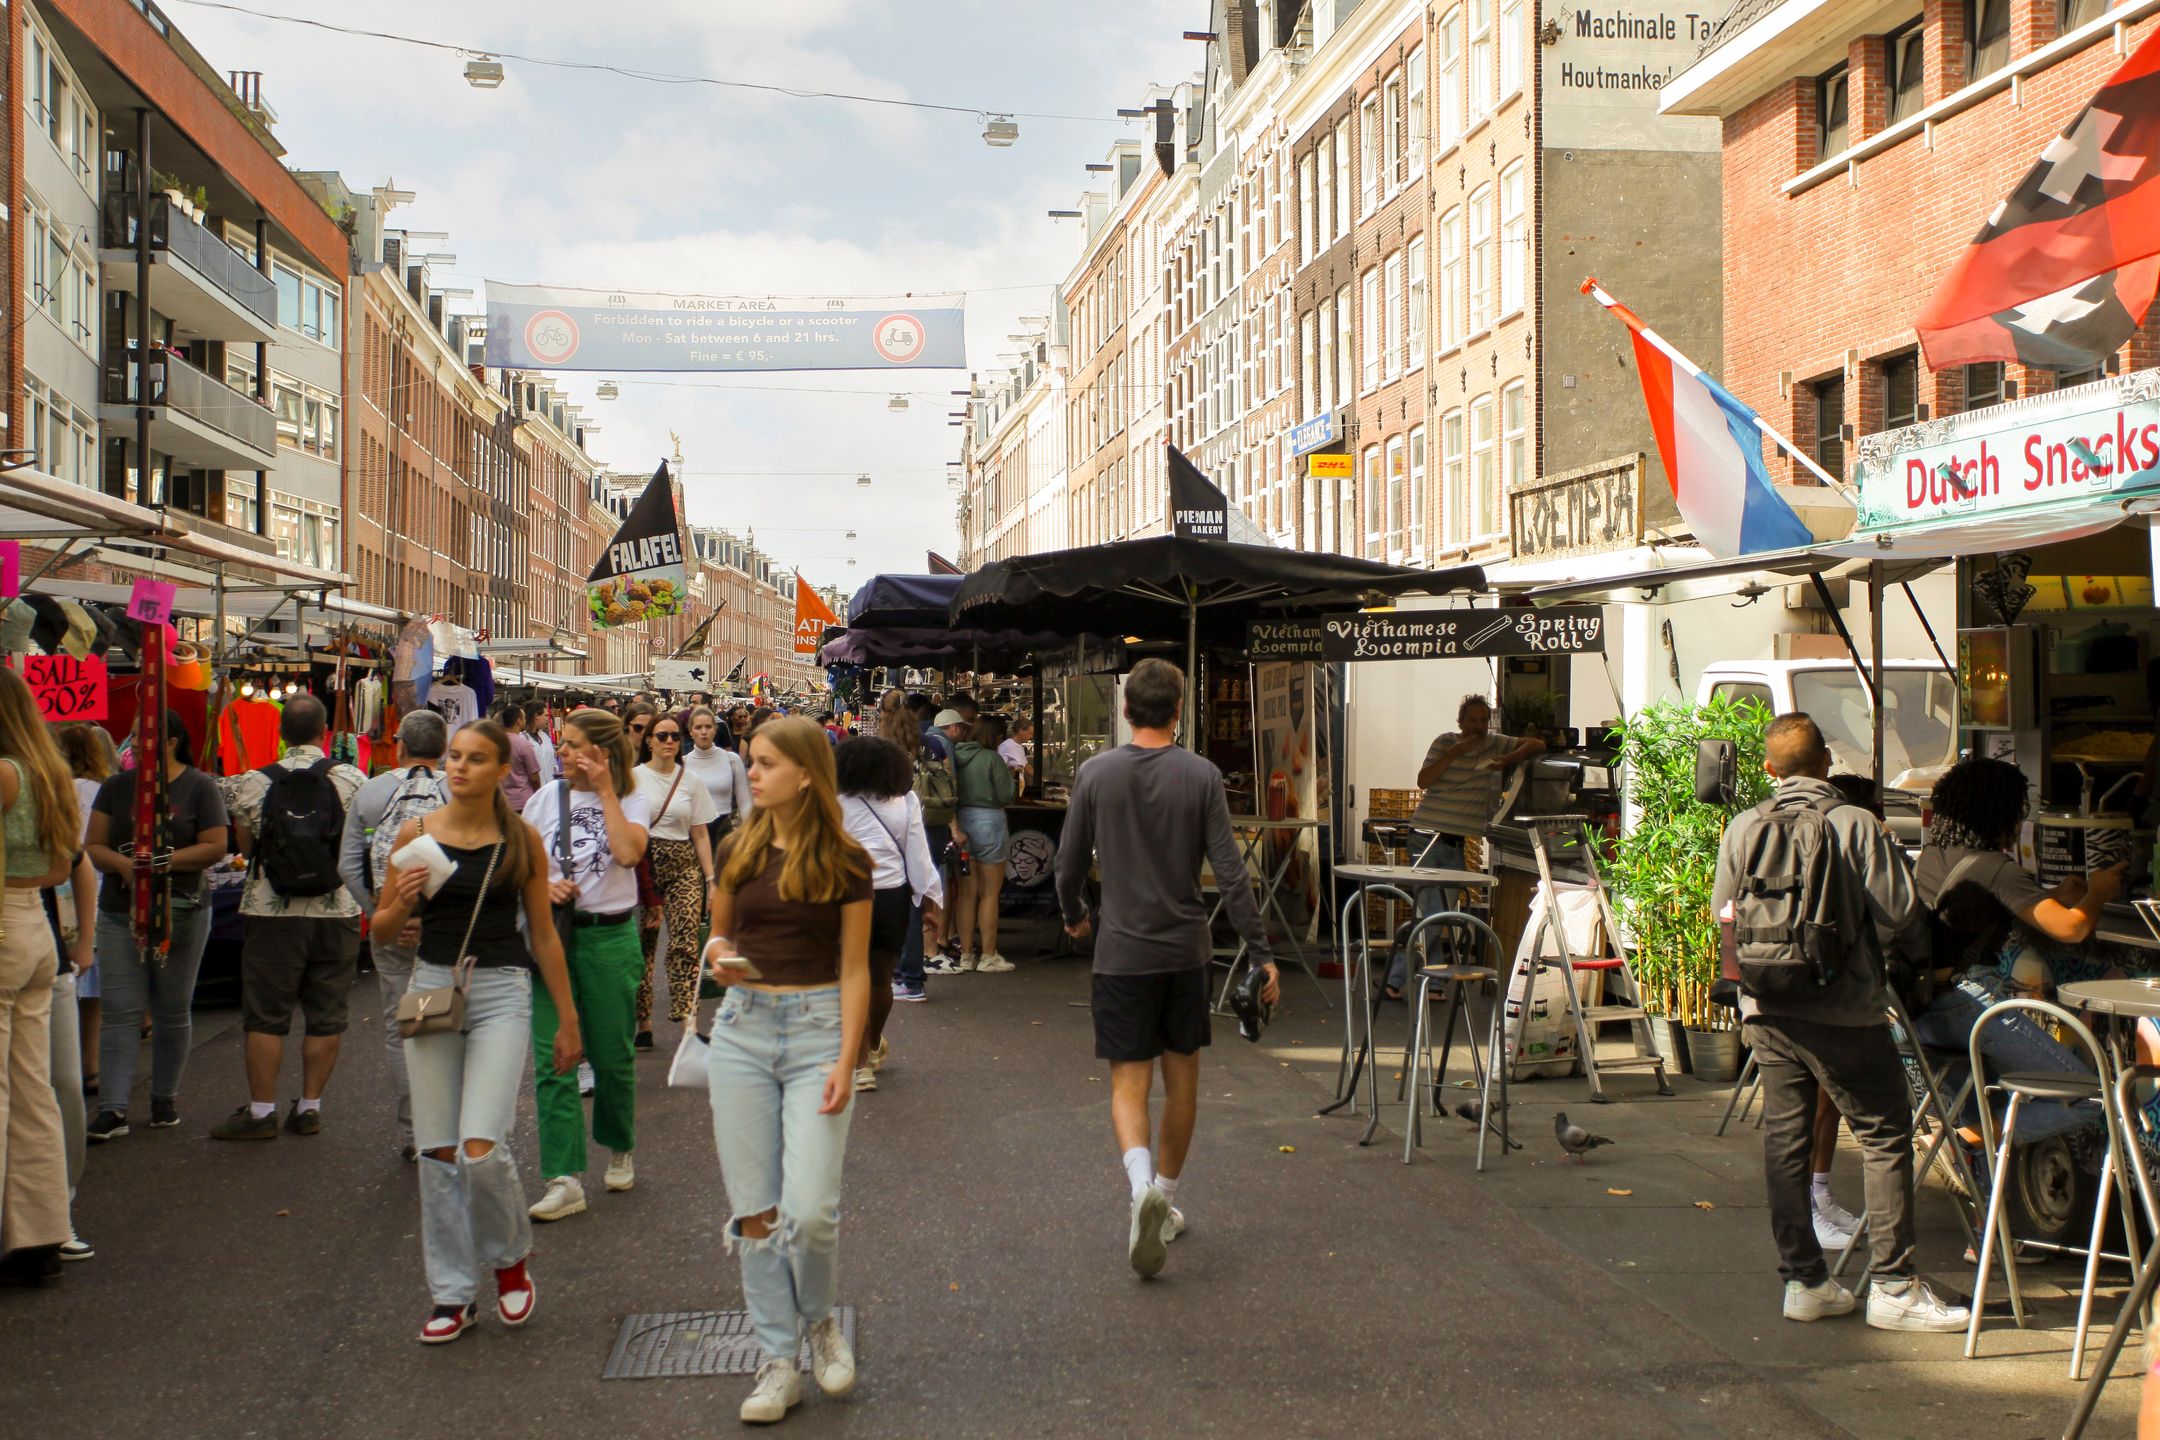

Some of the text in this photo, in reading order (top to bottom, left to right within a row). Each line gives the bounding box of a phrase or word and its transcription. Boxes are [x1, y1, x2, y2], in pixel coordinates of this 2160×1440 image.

[1576, 9, 1716, 41] Machinale Ta
[673, 299, 777, 311] MARKET AREA
[593, 313, 858, 329] Forbidden to ride a bicycle or a scooter
[622, 332, 652, 344] Mon
[665, 332, 687, 344] Sat
[691, 332, 749, 344] between
[753, 332, 761, 344] 6
[766, 332, 790, 343] and
[794, 332, 809, 343] 21
[814, 331, 839, 343] hrs.
[690, 351, 719, 362] Fine
[735, 350, 744, 362] €
[1316, 461, 1346, 469] DHL
[1906, 410, 2160, 509] Dutch Snacks
[1175, 510, 1223, 524] PIEMAN
[1518, 465, 1634, 554] LOEMPIA
[1191, 525, 1223, 534] BAKERY
[609, 532, 682, 574] FALAFEL
[1326, 619, 1457, 639] Vietnamese
[1515, 613, 1601, 640] Spring
[796, 635, 820, 646] INS
[1251, 639, 1323, 655] Loempia
[1353, 637, 1457, 658] Loempia
[1524, 631, 1583, 651] Roll
[27, 656, 89, 686] SALE
[37, 682, 97, 716] 50%
